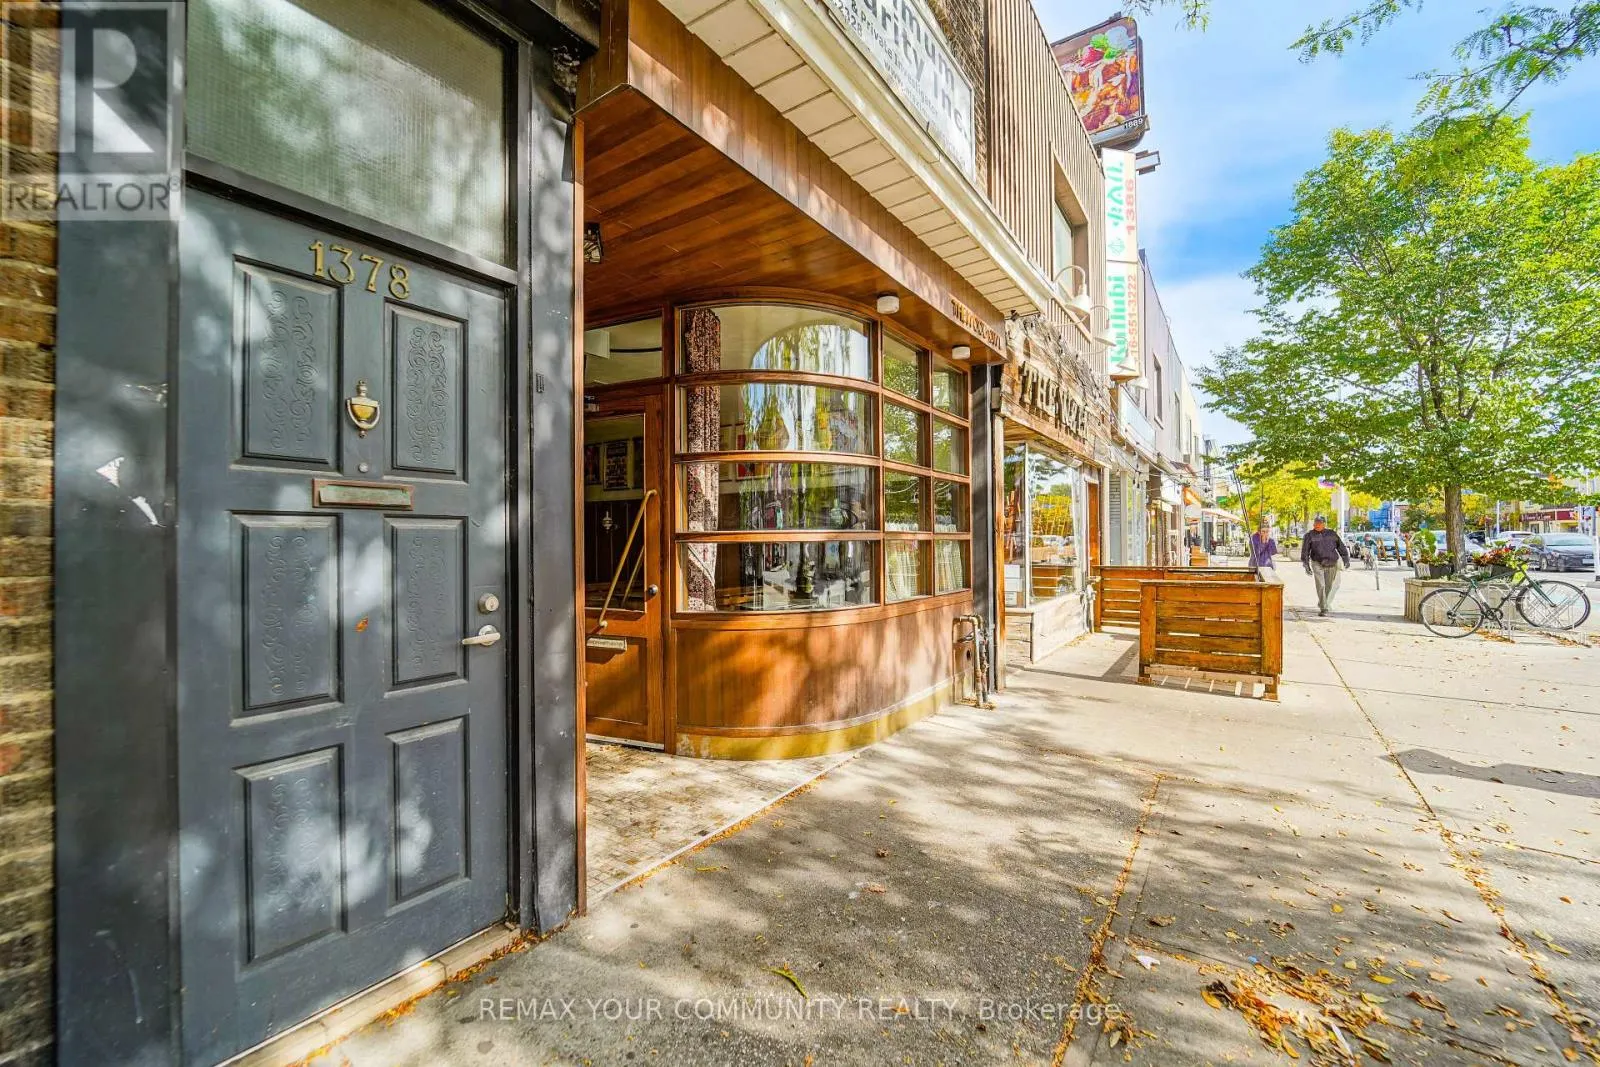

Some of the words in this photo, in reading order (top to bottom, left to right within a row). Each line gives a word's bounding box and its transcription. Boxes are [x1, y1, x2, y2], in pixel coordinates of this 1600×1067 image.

[860, 10, 893, 60] Private
[933, 71, 968, 138] Inc.
[308, 240, 411, 299] 1378
